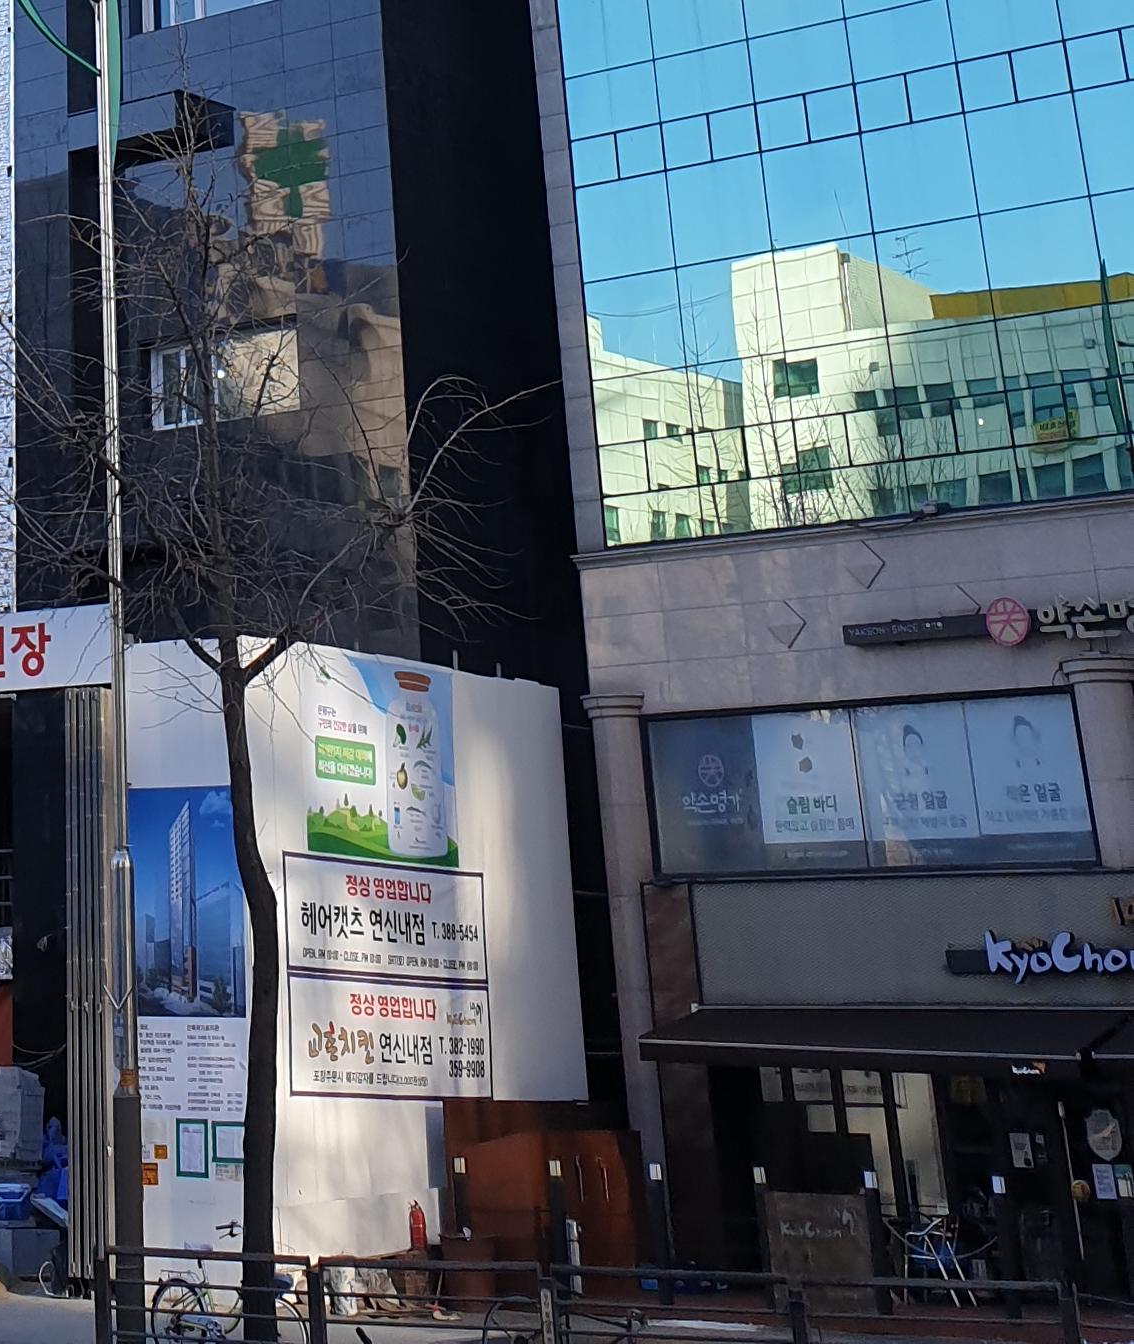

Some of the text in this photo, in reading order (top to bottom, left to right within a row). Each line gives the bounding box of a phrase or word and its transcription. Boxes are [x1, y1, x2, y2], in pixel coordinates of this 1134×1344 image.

[681, 789, 741, 813] 약손명가
[787, 794, 837, 815] 슬림 바디
[921, 790, 948, 810] 얼굴
[1034, 782, 1061, 802] 얼굴
[345, 874, 432, 904] 정상 영업합니다
[300, 901, 364, 940] 헤어캣츠
[369, 908, 426, 946] 연신내점
[441, 922, 479, 942] 388-5454
[984, 928, 1134, 985] KyoCho
[350, 993, 437, 1021] 정상 영업합니다
[308, 1021, 375, 1064] 교촌치킨
[379, 1032, 433, 1065] 연신내점
[449, 1037, 485, 1056] 382-1990
